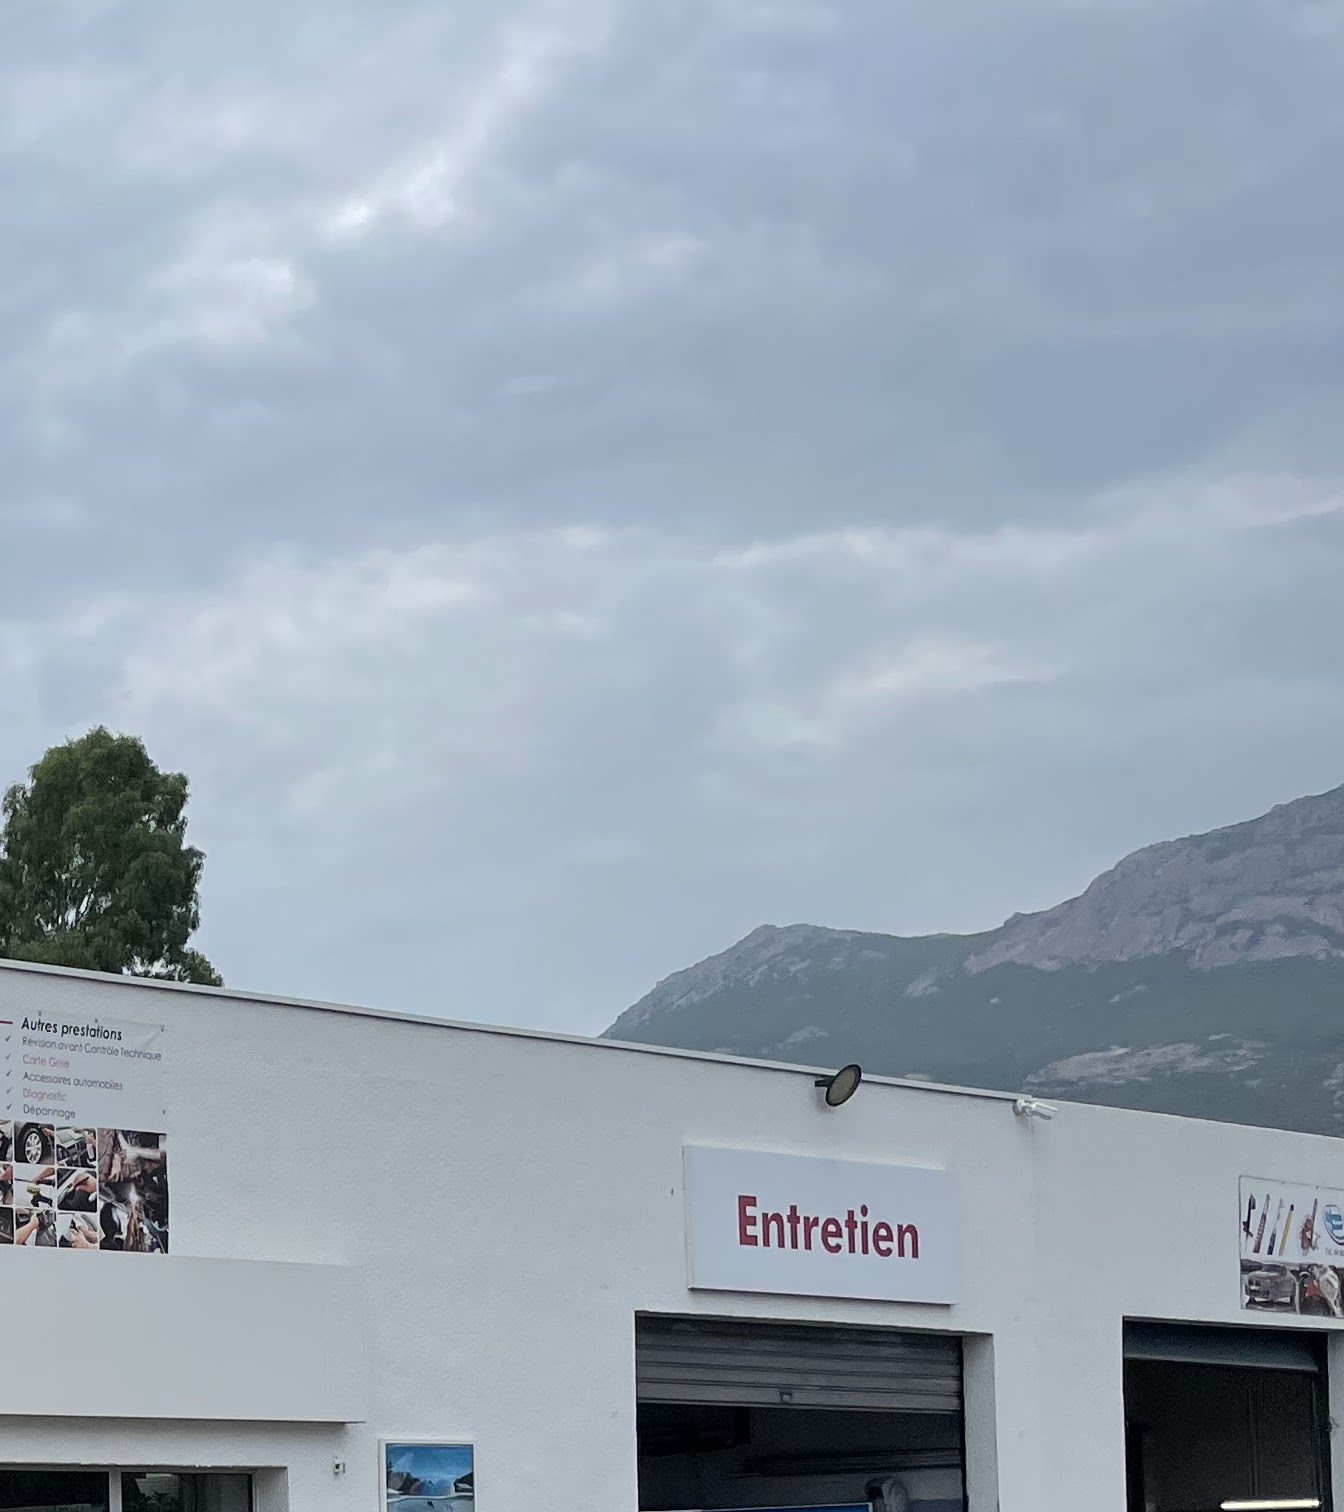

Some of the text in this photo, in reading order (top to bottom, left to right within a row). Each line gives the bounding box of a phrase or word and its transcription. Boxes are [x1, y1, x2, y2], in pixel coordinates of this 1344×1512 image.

[21, 1017, 123, 1041] Autres prestations
[58, 1042, 83, 1052] avant
[22, 1054, 46, 1066] Carte
[23, 1072, 123, 1091] Accessoires automobiles
[23, 1088, 67, 1101] Diagnostic
[23, 1104, 76, 1120] Dépannage
[737, 1194, 920, 1260] Entretien
